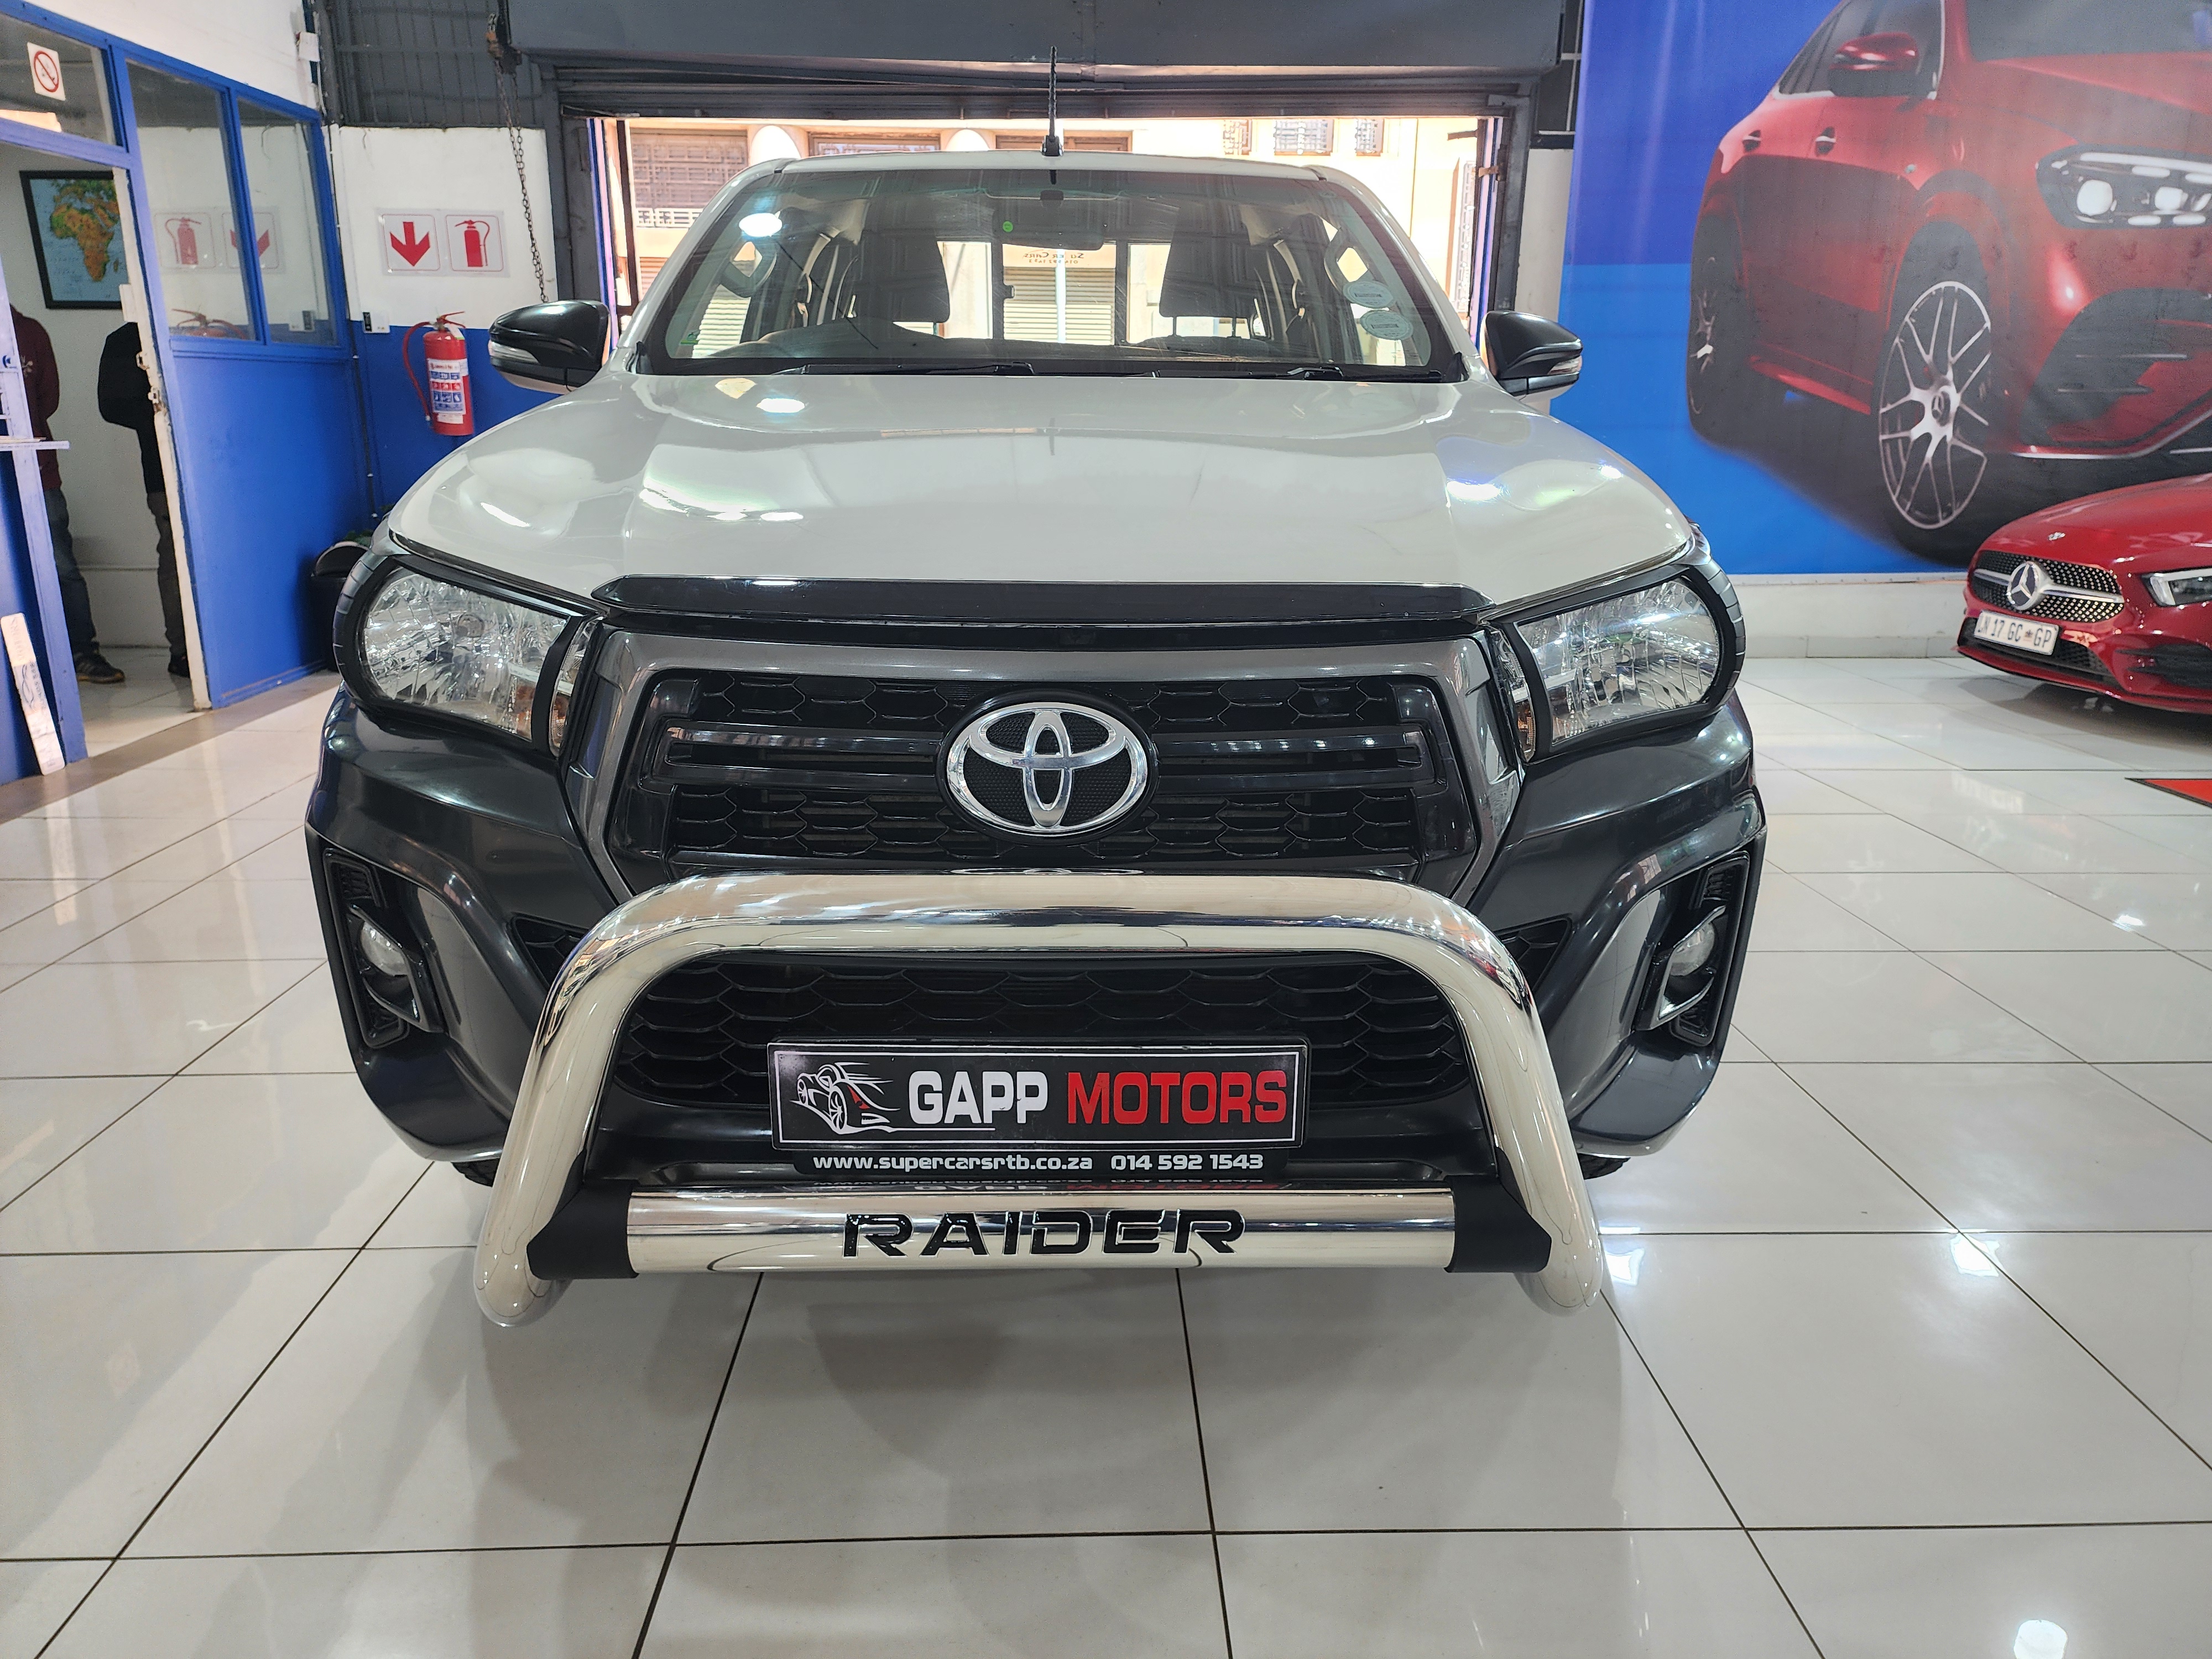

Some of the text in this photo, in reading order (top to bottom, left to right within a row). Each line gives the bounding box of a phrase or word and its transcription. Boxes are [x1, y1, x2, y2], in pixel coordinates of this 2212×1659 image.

[1991, 618, 2005, 638] 17
[2007, 622, 2023, 642] GC
[2033, 628, 2052, 648] GP
[909, 1070, 1287, 1124] GAPP MOTORS
[813, 1154, 1264, 1172] www.supercarsrtb.co.za 014 592 1543
[842, 1209, 1245, 1258] RAIDER
